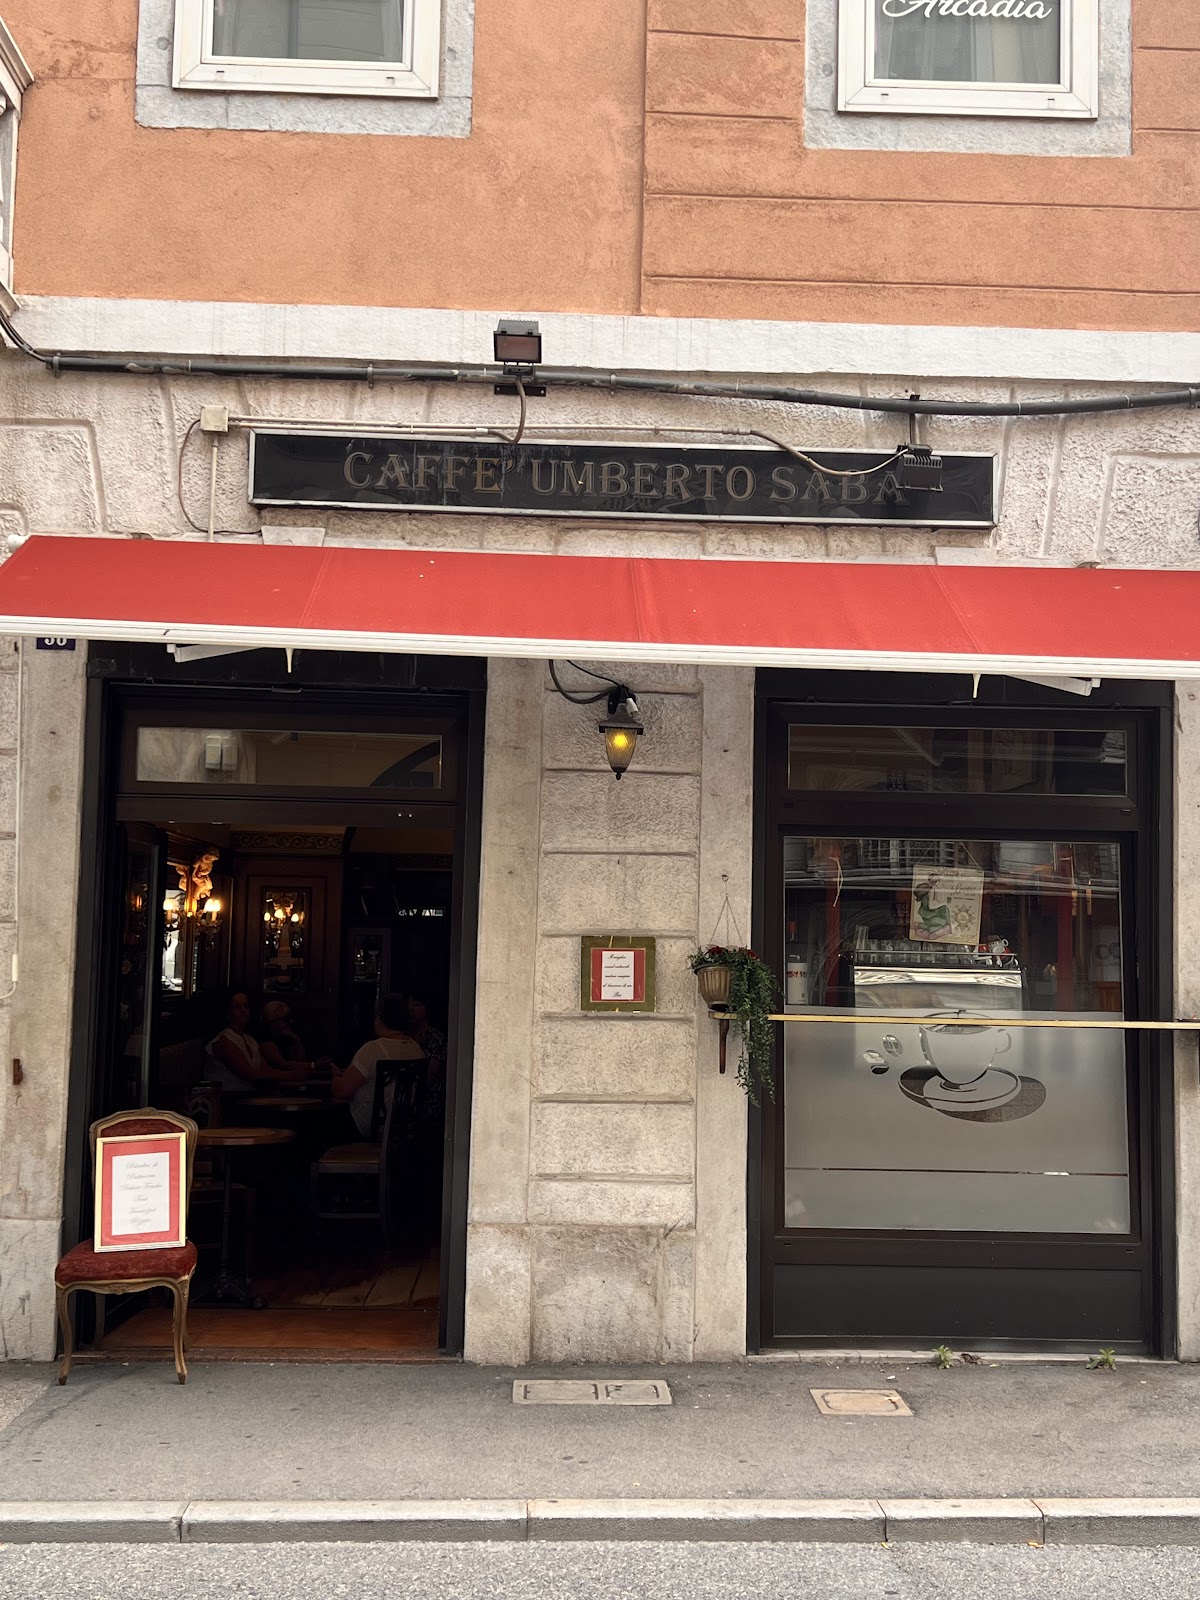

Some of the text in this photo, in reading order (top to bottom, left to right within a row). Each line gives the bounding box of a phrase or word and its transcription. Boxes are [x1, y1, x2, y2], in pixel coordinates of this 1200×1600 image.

[343, 451, 910, 506] CAFFE' UMBERTO SABA
